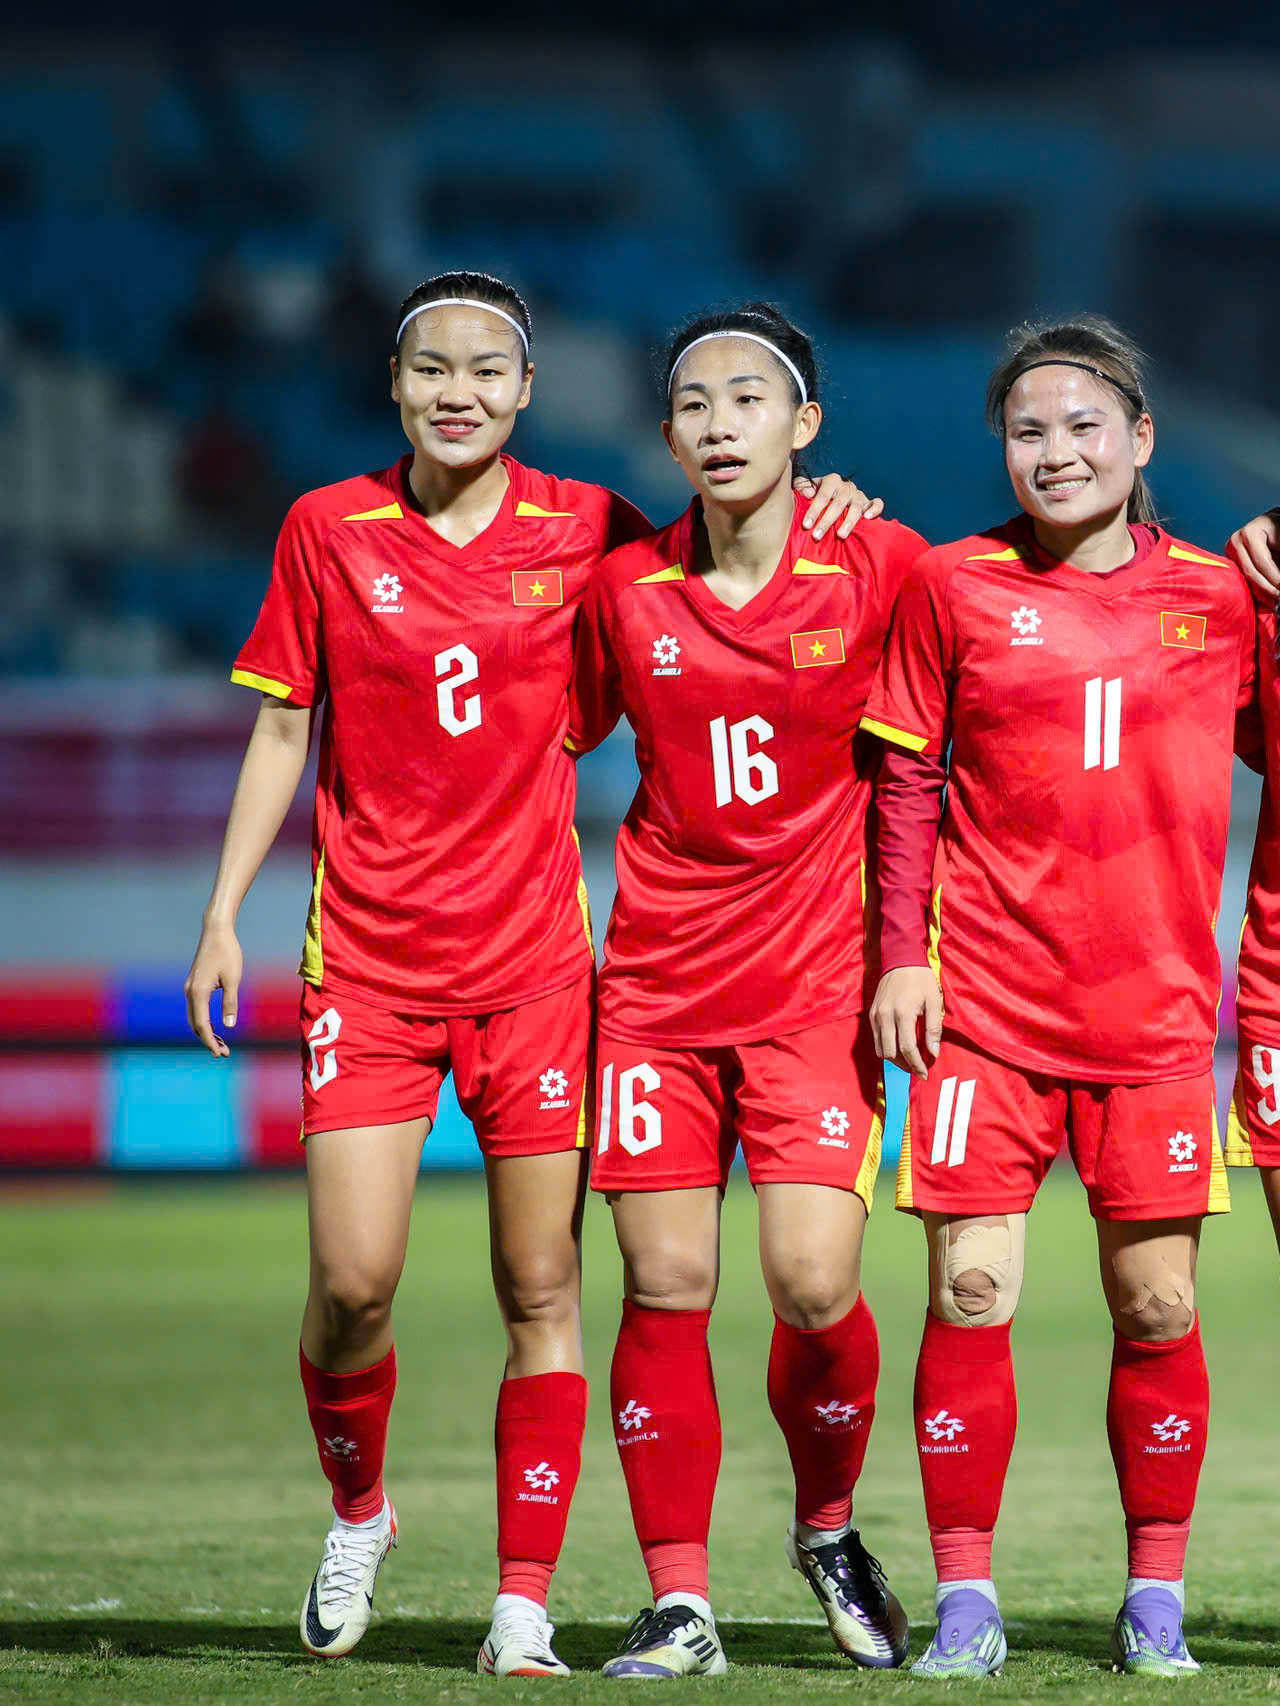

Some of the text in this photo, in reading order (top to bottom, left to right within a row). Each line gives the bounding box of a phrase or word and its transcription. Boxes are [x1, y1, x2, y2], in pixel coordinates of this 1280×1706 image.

[434, 643, 482, 737] 2
[1084, 676, 1122, 771] 11
[709, 714, 779, 809] 16
[307, 1007, 342, 1093] 2
[597, 1062, 662, 1157] 16
[929, 1075, 977, 1168] 11
